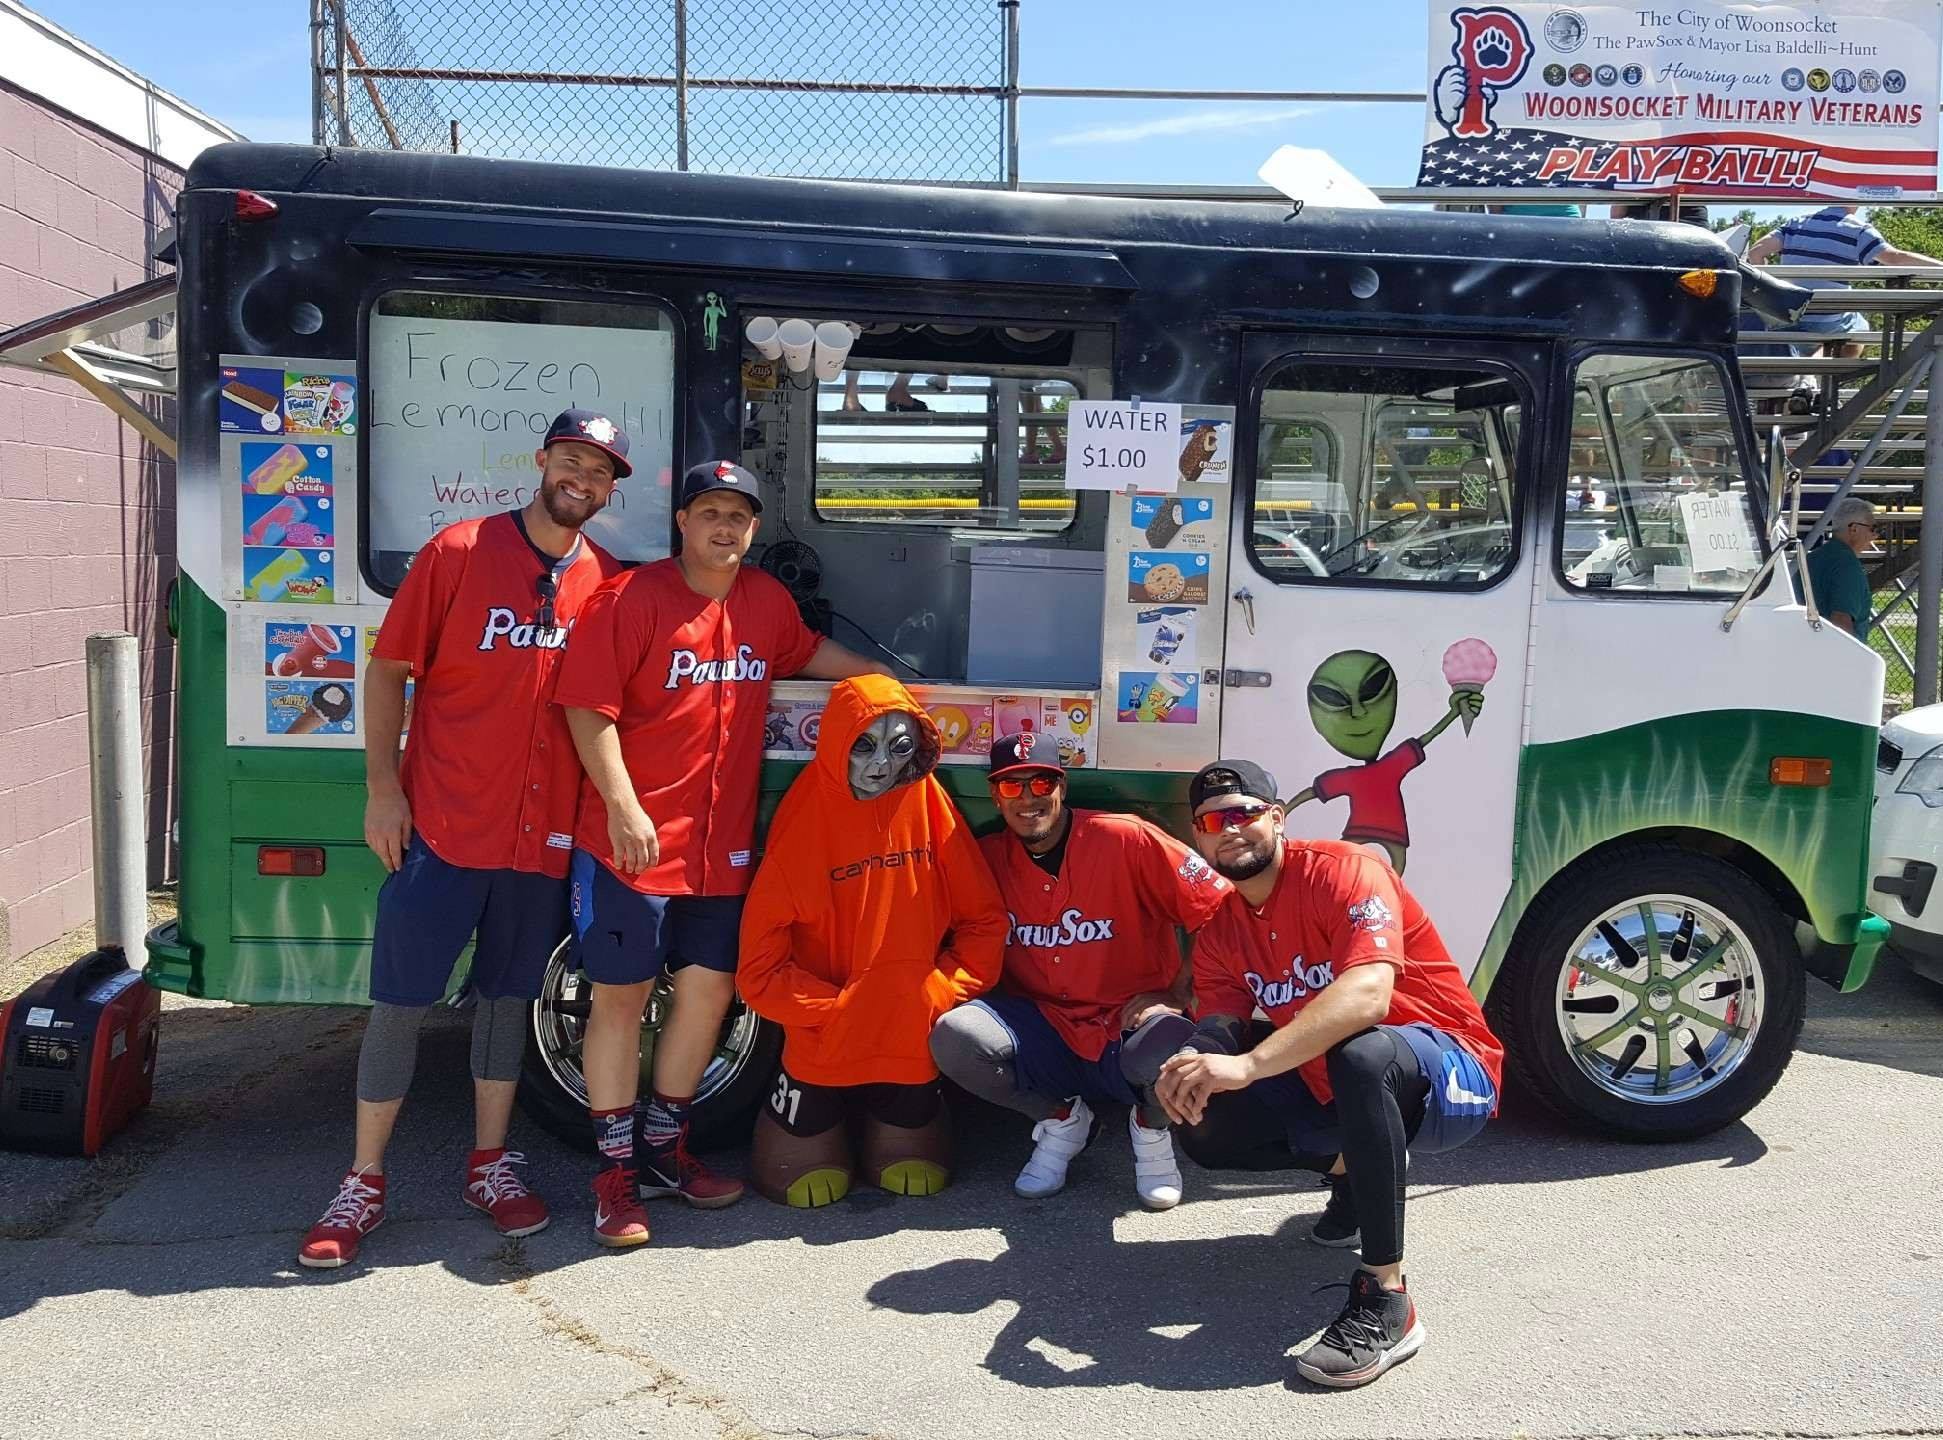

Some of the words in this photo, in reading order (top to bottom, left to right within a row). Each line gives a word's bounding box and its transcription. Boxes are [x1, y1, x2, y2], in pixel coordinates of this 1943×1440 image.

[1636, 10, 1674, 27] The
[1677, 9, 1711, 33] City
[1715, 13, 1731, 31] of
[1735, 14, 1838, 34] Woonsocket
[1593, 35, 1622, 50] The
[1626, 34, 1683, 51] PawSox
[1687, 34, 1697, 48] &
[1699, 38, 1742, 56] Mayor
[1746, 40, 1772, 55] Lisa
[1658, 62, 1737, 91] Honoring
[1742, 72, 1773, 88] our
[1524, 92, 1689, 119] WOONSOCKET
[1696, 93, 1803, 122] MILITARY
[1809, 97, 1922, 125] VETERANS
[1537, 146, 1679, 183] PLAY
[1676, 146, 1818, 188] BALL!
[405, 332, 601, 398] Frozen
[369, 389, 576, 432] Lemona
[1084, 409, 1168, 432] WATER
[1082, 443, 1146, 469] $1.00
[1199, 460, 1228, 471] CRUNCH
[292, 475, 321, 485] Cotton
[296, 484, 325, 493] Candy
[478, 607, 577, 651] Paw
[1044, 714, 1057, 726] ME
[830, 841, 934, 881] carhartt
[1242, 954, 1335, 1009] PawSox
[770, 1072, 802, 1126] 31
